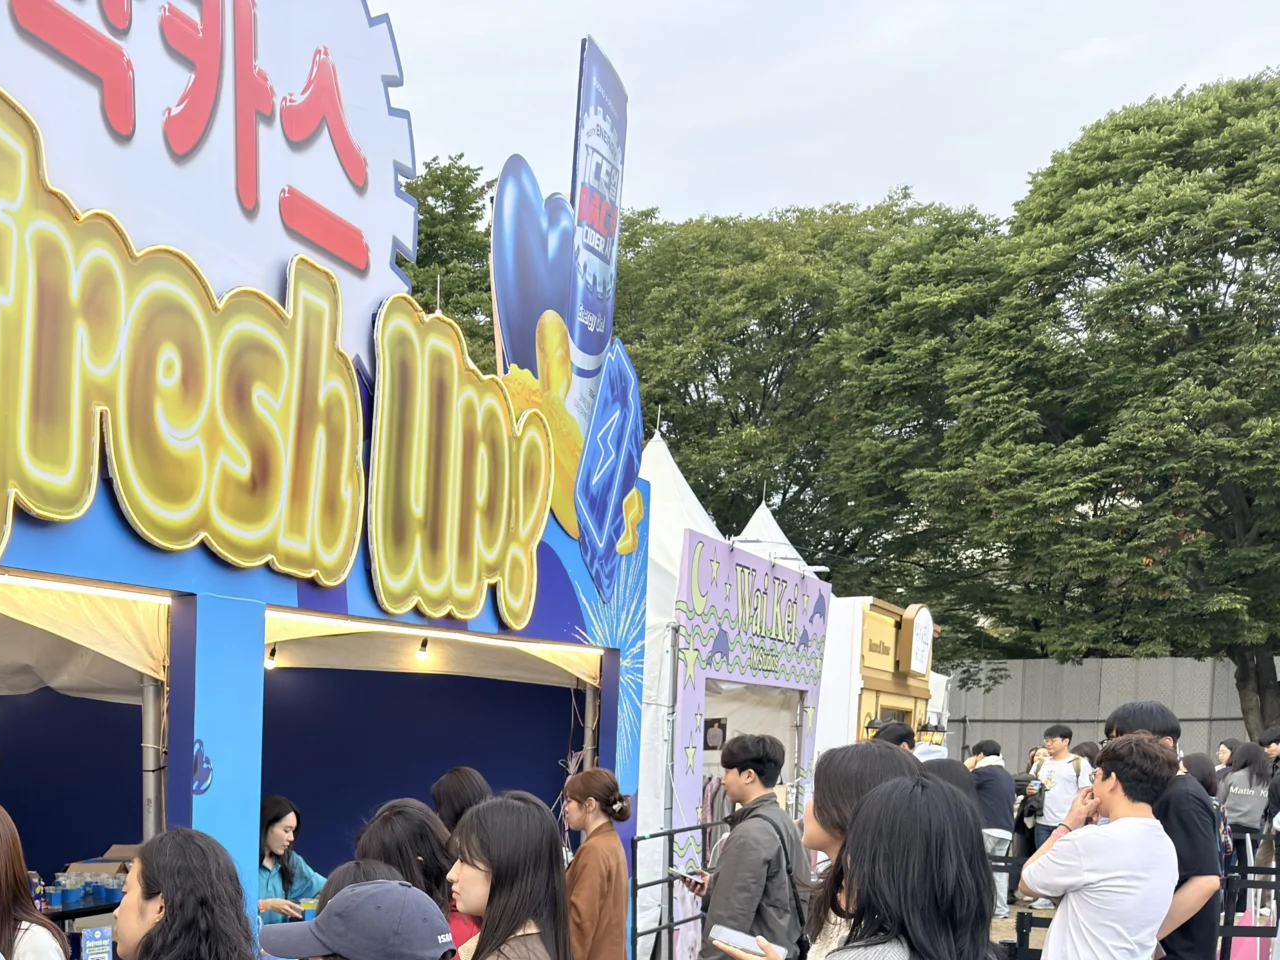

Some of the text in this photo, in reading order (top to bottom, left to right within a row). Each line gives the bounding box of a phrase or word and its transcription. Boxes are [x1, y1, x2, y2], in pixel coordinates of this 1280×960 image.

[9, 0, 370, 270] 카스
[735, 563, 799, 645] Wai Kei
[1229, 786, 1255, 796] Matin
